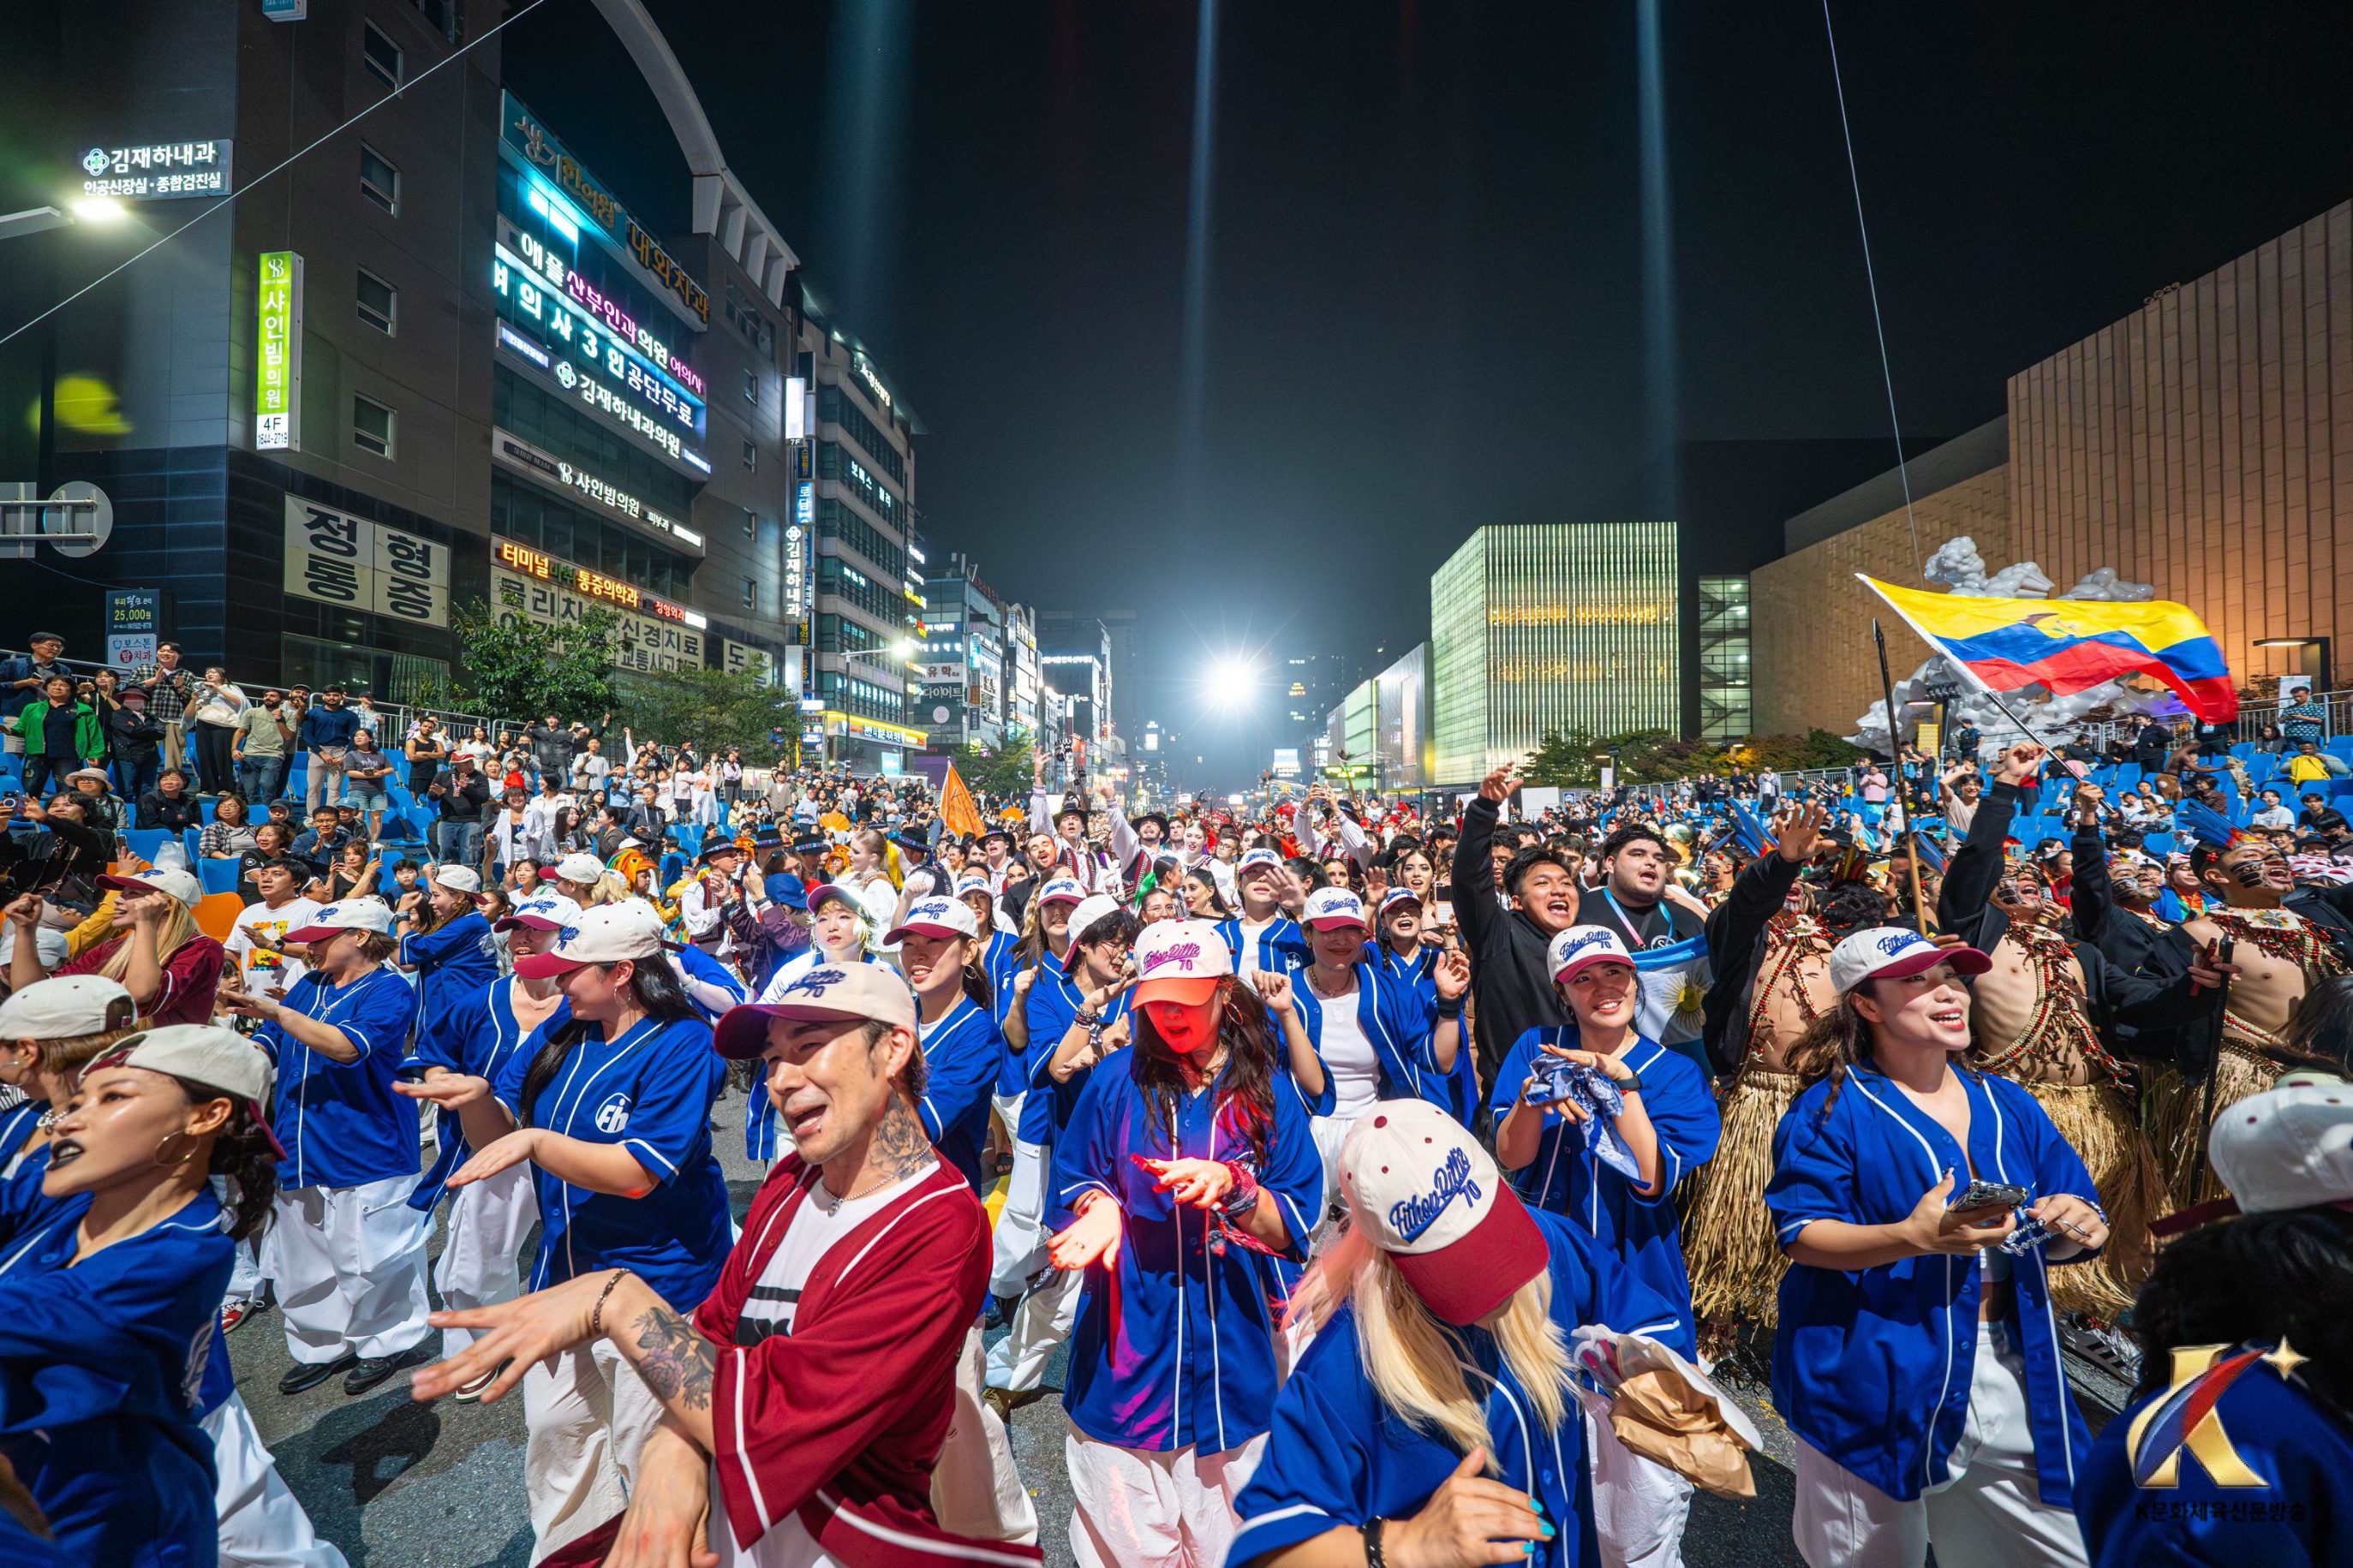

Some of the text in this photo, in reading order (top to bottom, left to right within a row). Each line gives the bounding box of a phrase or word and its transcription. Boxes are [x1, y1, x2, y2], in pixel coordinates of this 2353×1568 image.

[110, 142, 217, 173] 김재하내과
[84, 171, 221, 196] 인공신장실 종합검진실
[264, 289, 285, 409] 샤인빔의원
[263, 417, 282, 431] 4F
[578, 373, 680, 459] 김재하내과의원
[258, 432, 288, 445] 1644-2719
[576, 472, 640, 519] 샤인빔의원
[502, 542, 549, 579] 터미널
[577, 569, 639, 608] 통증의학과
[785, 541, 802, 618] 김재하내과
[622, 617, 700, 656] 신경치료
[923, 686, 962, 699] 다이어트
[928, 912, 940, 921] 70
[1598, 940, 1612, 950] 70
[1179, 958, 1193, 971] 70
[803, 984, 825, 999] 70
[1459, 1178, 1481, 1208] 70
